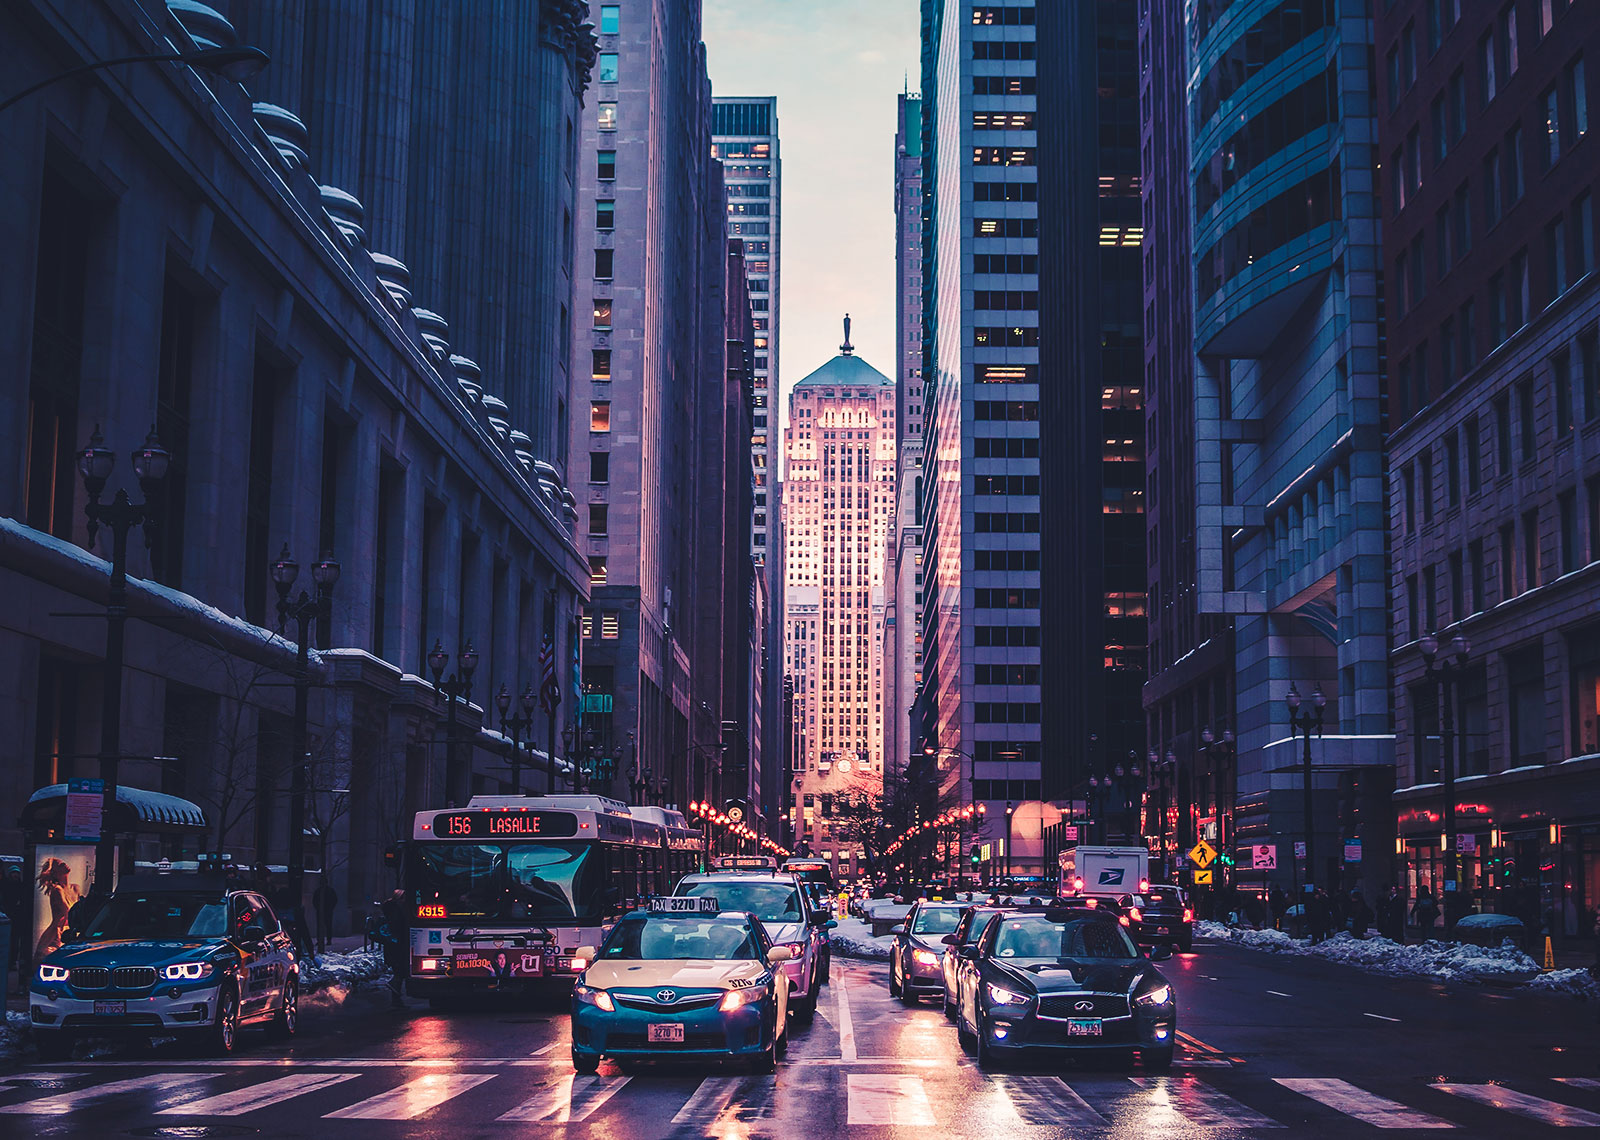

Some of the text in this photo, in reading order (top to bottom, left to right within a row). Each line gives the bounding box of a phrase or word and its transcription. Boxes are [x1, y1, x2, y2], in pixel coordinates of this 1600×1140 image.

[448, 816, 541, 834] 156 LASALLE
[418, 906, 444, 917] K915
[671, 898, 695, 911] 3270
[700, 899, 717, 912] TAXI
